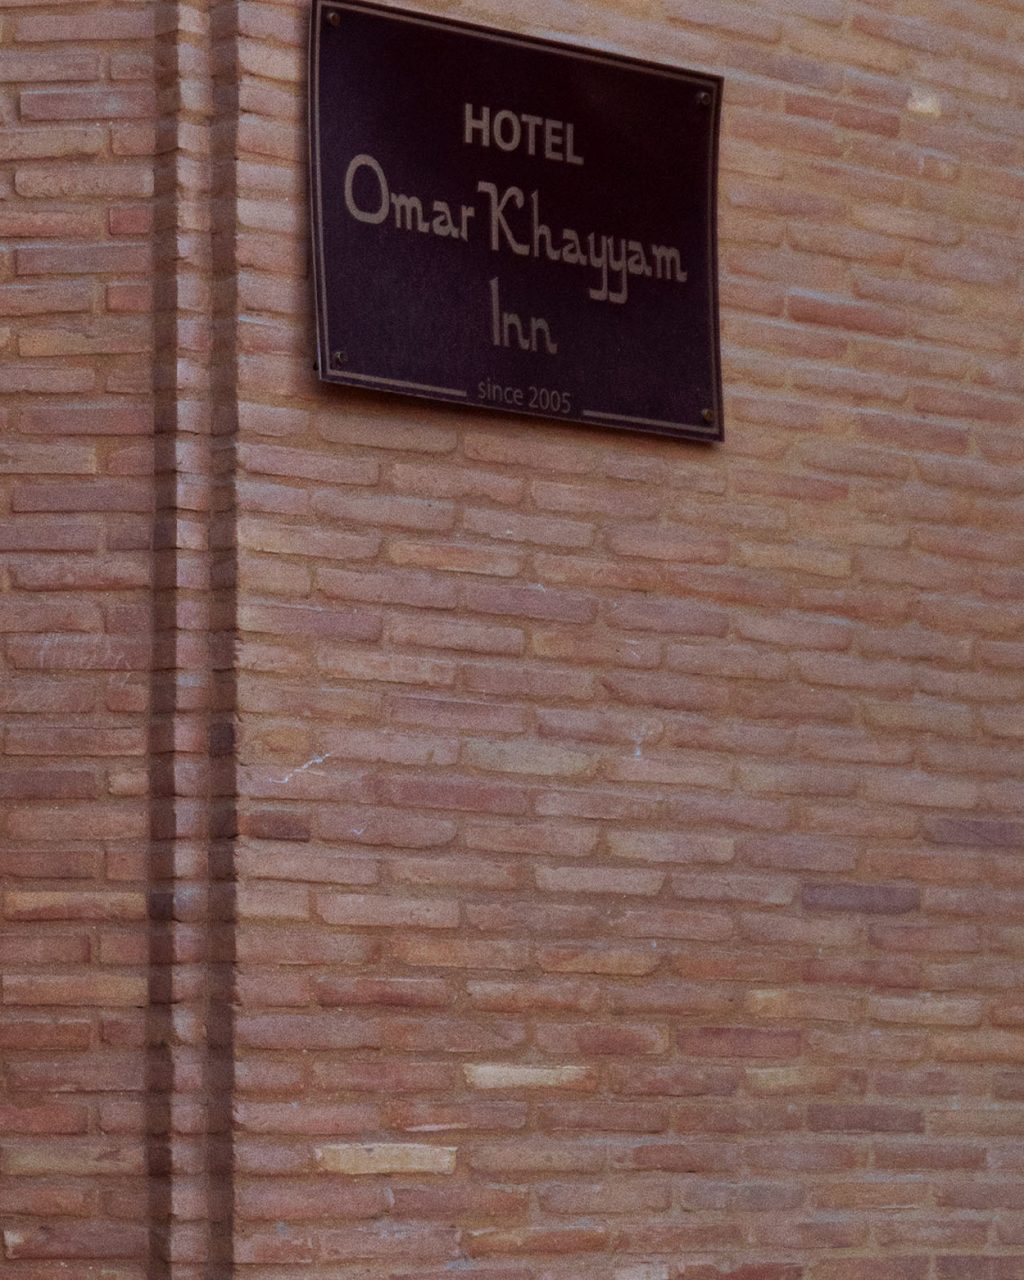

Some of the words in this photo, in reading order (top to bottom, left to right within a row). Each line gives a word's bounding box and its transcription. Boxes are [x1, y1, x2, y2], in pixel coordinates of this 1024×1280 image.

[464, 103, 585, 166] HOTEL
[344, 153, 475, 242] Omar
[477, 180, 688, 304] Khayyam
[489, 276, 558, 355] Inn
[477, 376, 525, 407] since
[528, 385, 572, 413] 2005
